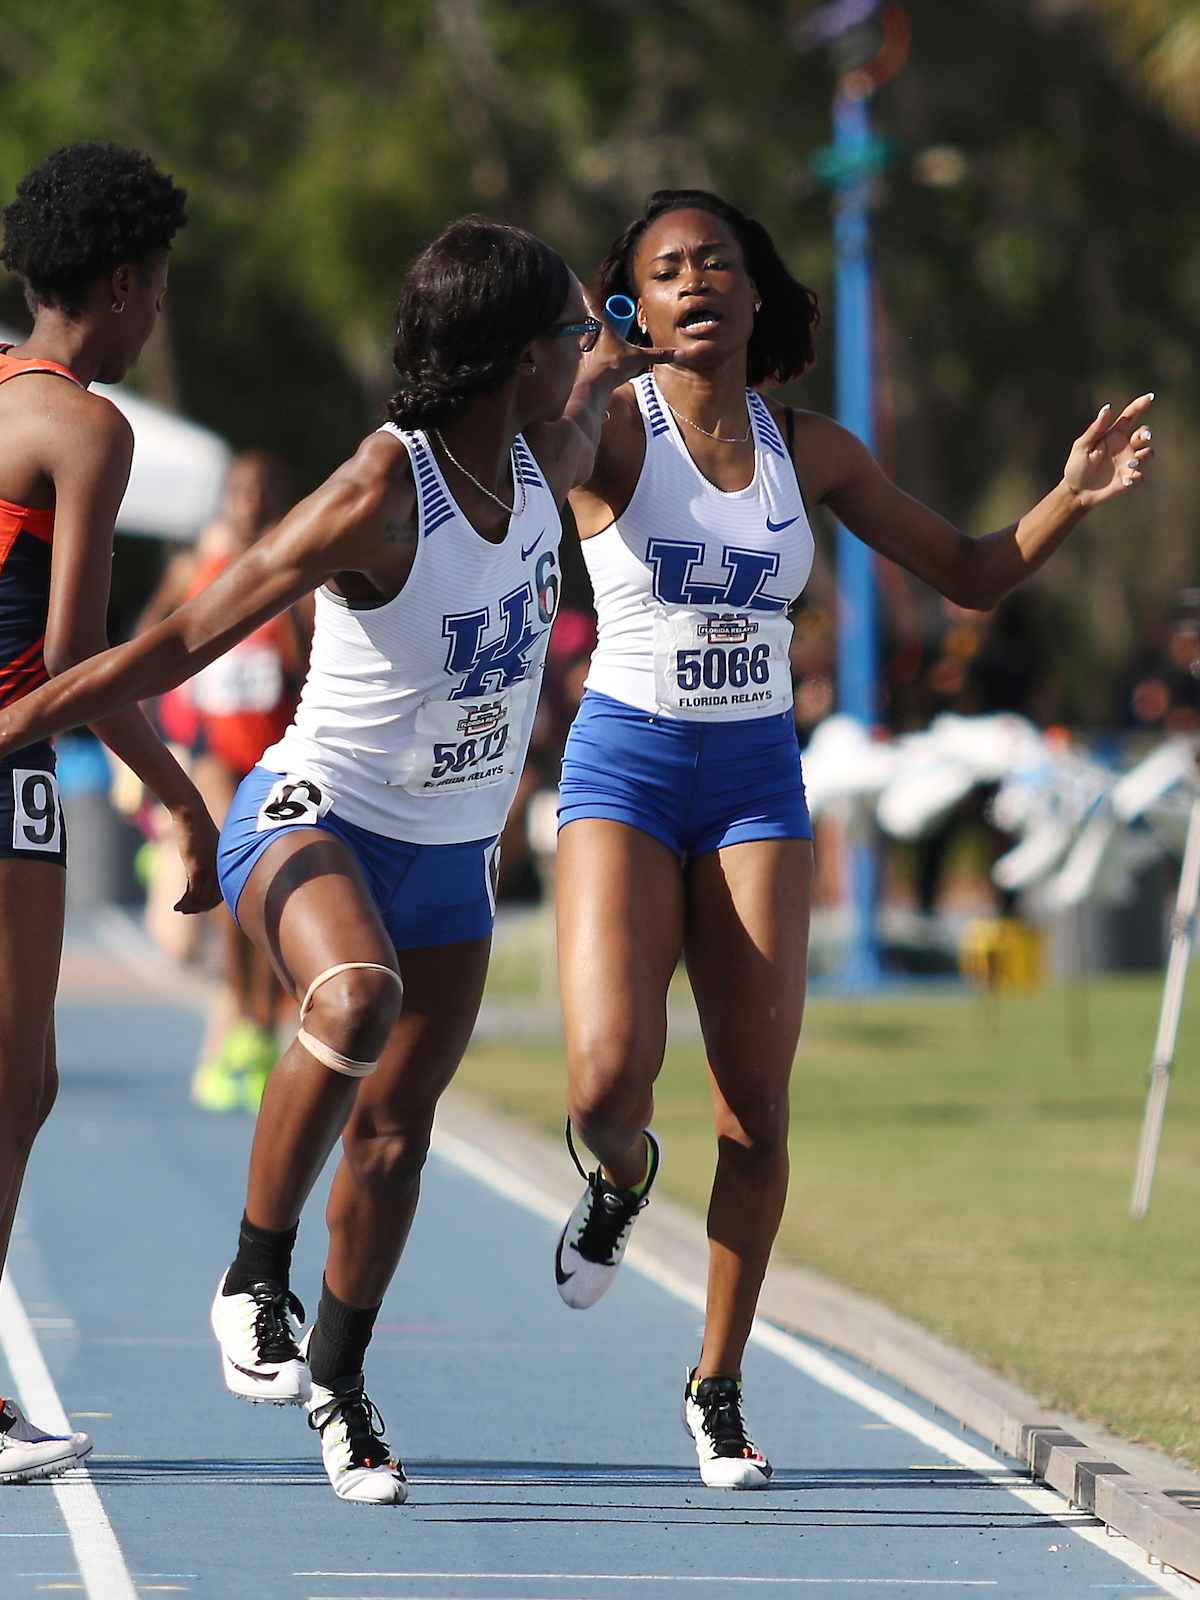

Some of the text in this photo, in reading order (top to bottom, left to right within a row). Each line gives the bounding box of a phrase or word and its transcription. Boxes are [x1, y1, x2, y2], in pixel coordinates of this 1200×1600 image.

[535, 550, 558, 624] 6
[677, 643, 770, 691] 5066
[678, 690, 773, 708] FLORIDA RELAYS
[431, 723, 509, 779] 5072
[264, 780, 322, 821] 6
[423, 765, 504, 788] FRIDA RELAYS
[21, 774, 56, 845] 9
